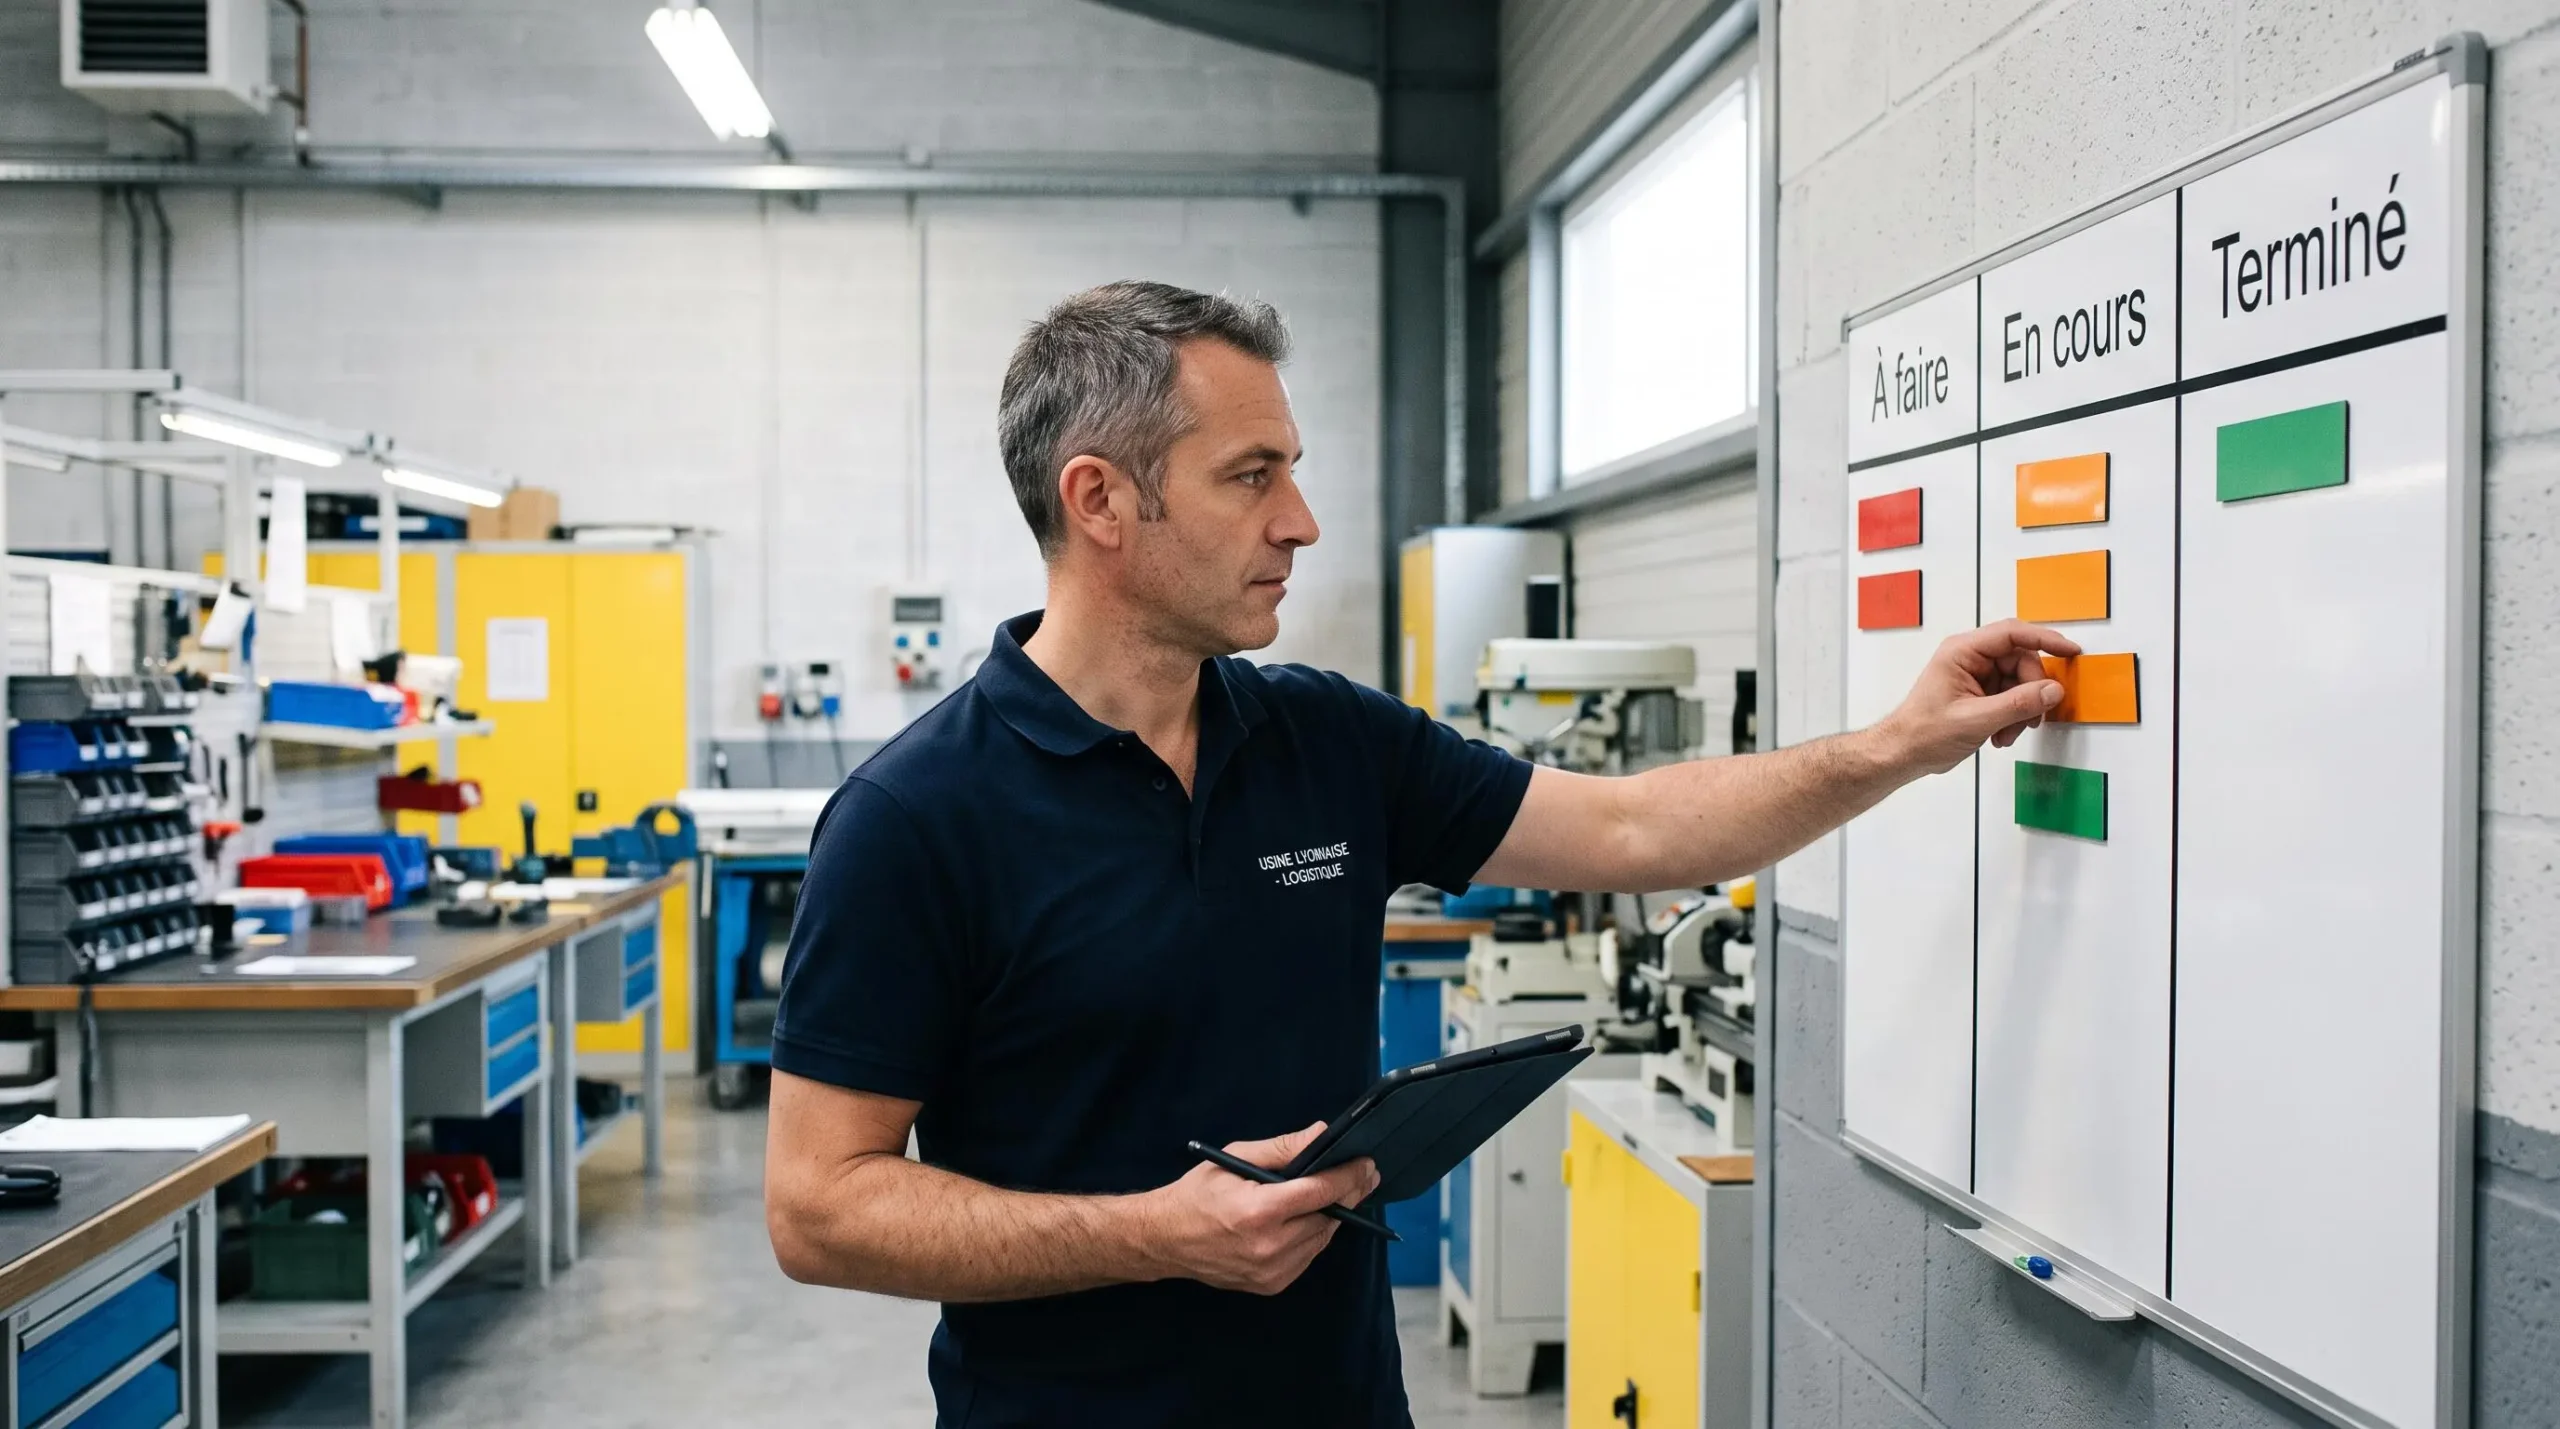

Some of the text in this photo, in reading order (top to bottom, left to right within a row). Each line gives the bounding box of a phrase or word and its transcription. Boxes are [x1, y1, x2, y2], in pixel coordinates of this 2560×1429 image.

[2211, 172, 2408, 319] Terminé
[2003, 288, 2147, 384] En cours
[1871, 346, 1950, 423] À faire
[1258, 842, 1349, 870] USINE LYONNAISE
[1282, 863, 1344, 885] LOGISTIQUE
